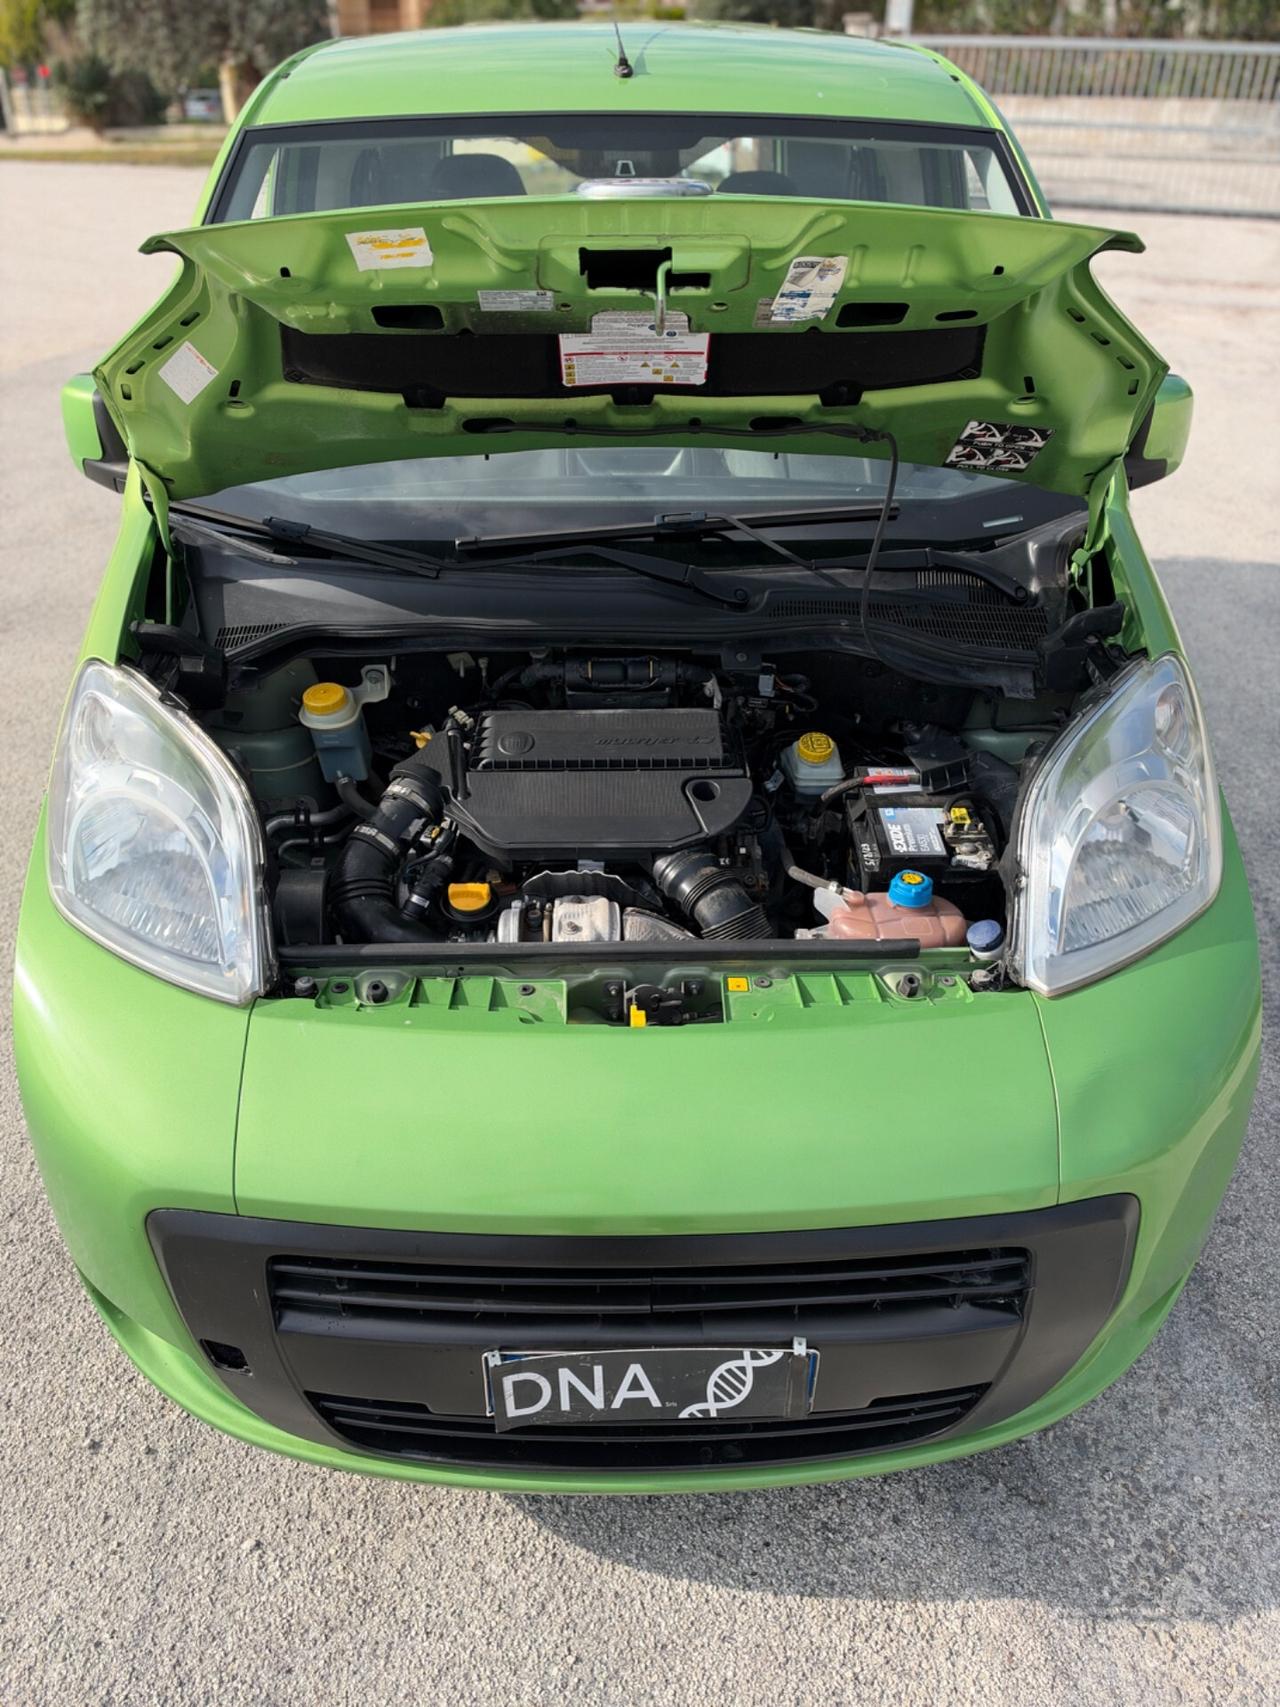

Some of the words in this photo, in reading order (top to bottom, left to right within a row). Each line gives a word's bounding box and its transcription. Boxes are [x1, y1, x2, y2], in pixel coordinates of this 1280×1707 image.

[888, 823, 907, 853] EXIDE
[903, 823, 919, 852] Premium
[502, 1363, 662, 1418] DNA
